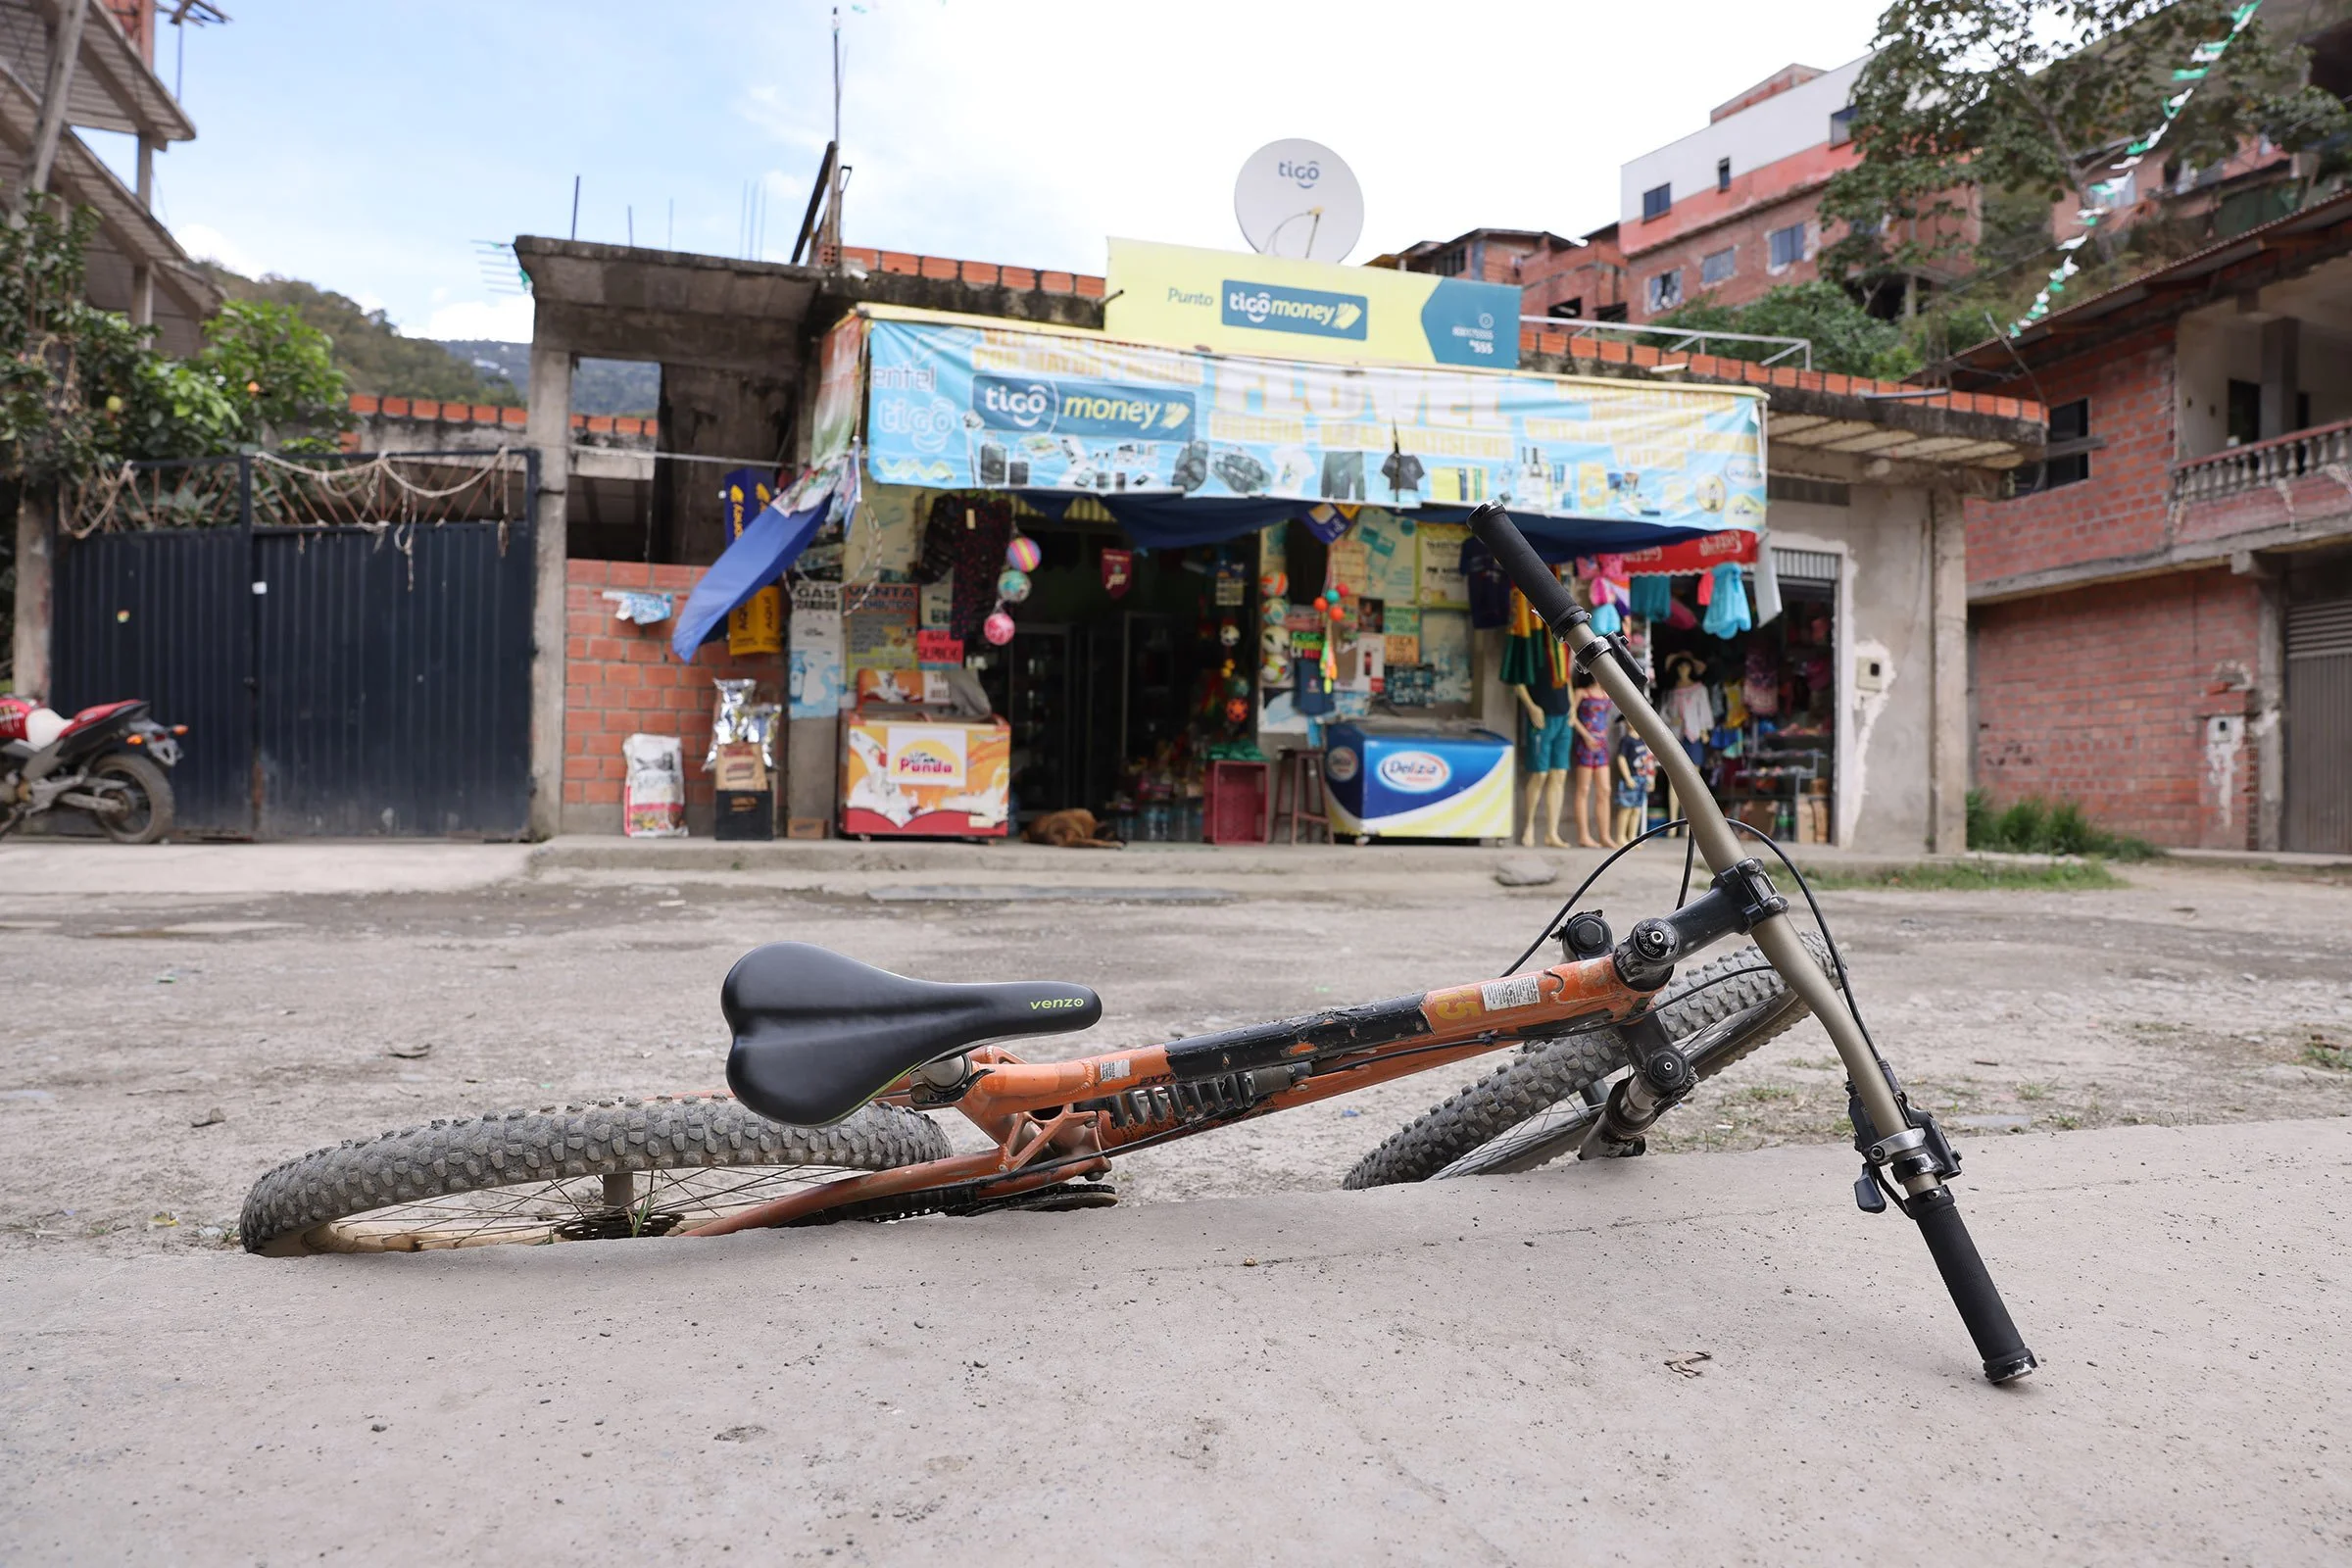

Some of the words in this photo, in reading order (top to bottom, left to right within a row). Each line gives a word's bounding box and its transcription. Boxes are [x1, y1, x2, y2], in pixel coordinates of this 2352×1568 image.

[1167, 287, 1214, 308] Punto
[1062, 395, 1161, 431] money
[1030, 998, 1085, 1010] venzo
